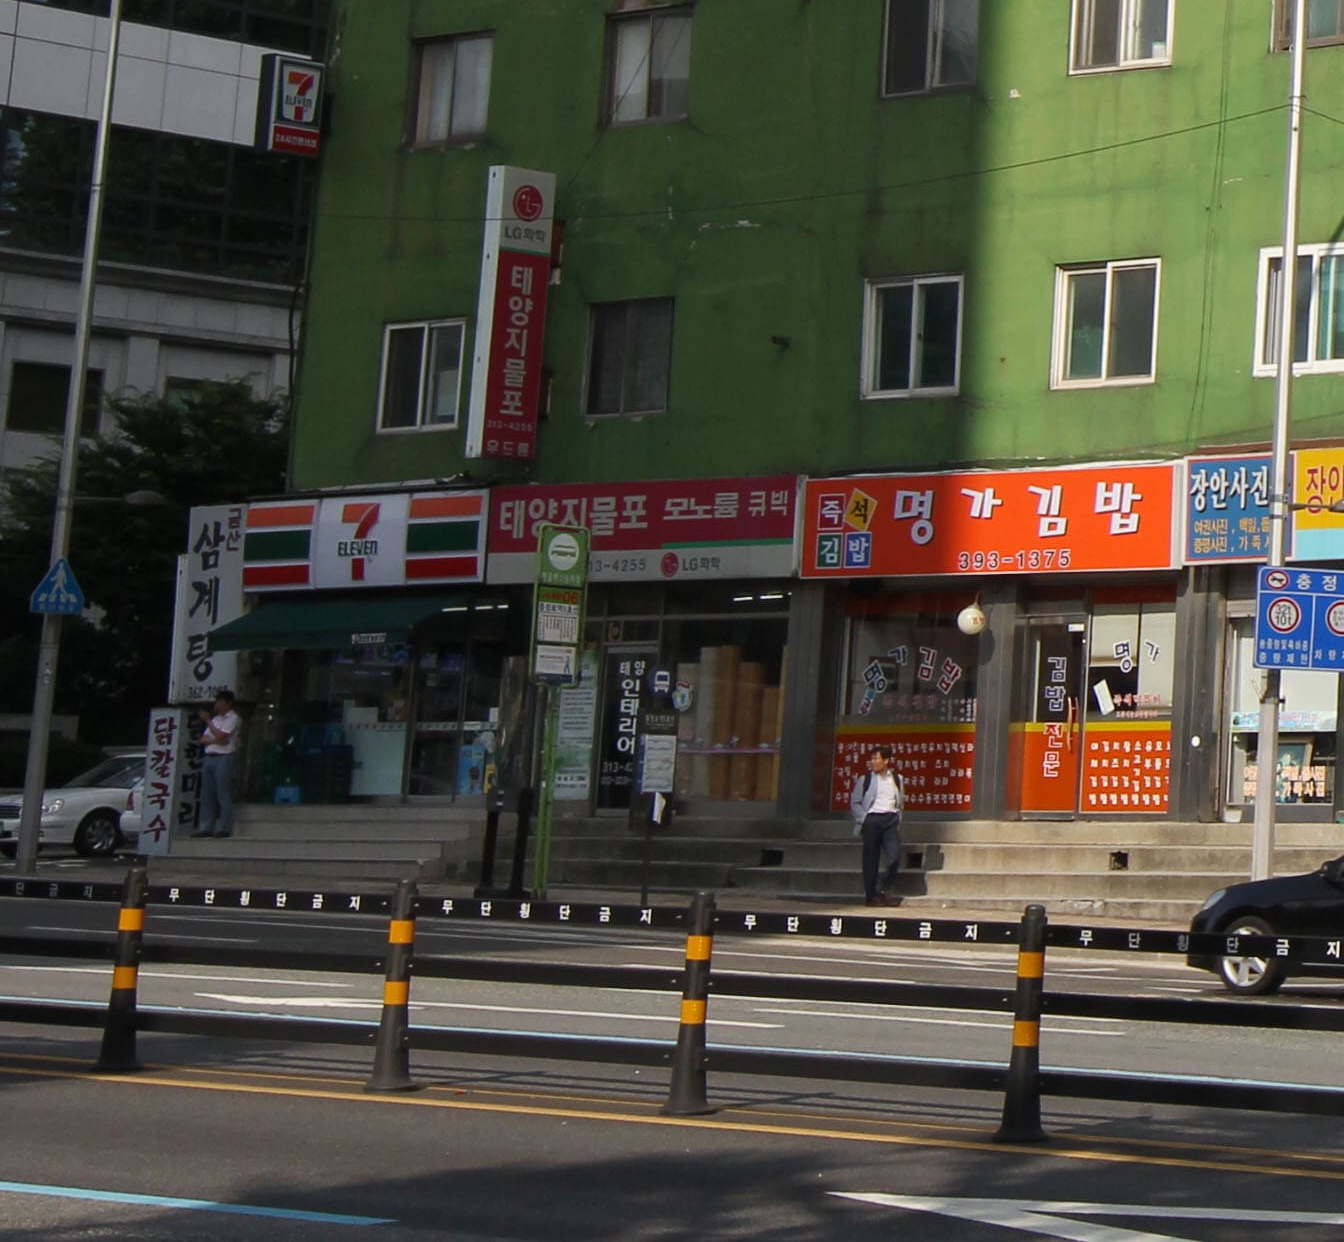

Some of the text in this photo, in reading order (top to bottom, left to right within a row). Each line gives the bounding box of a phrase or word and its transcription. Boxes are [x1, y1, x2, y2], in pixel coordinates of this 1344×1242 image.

[288, 70, 315, 122] 7
[504, 225, 545, 244] LG화학
[499, 265, 533, 417] 태양지물포
[820, 498, 869, 525] 즉석
[1189, 465, 1270, 512] 장안사진
[500, 494, 649, 539] 태양지물포
[341, 502, 382, 580] 7
[819, 536, 870, 565] 김밥
[958, 549, 1072, 571] 393-1375
[586, 558, 648, 572] 13-4255
[186, 521, 226, 682] 삼계탕
[620, 660, 646, 676] 태양
[617, 679, 640, 755] 인테리어
[1042, 722, 1064, 778] 전문
[144, 716, 177, 843] 닭칼국수
